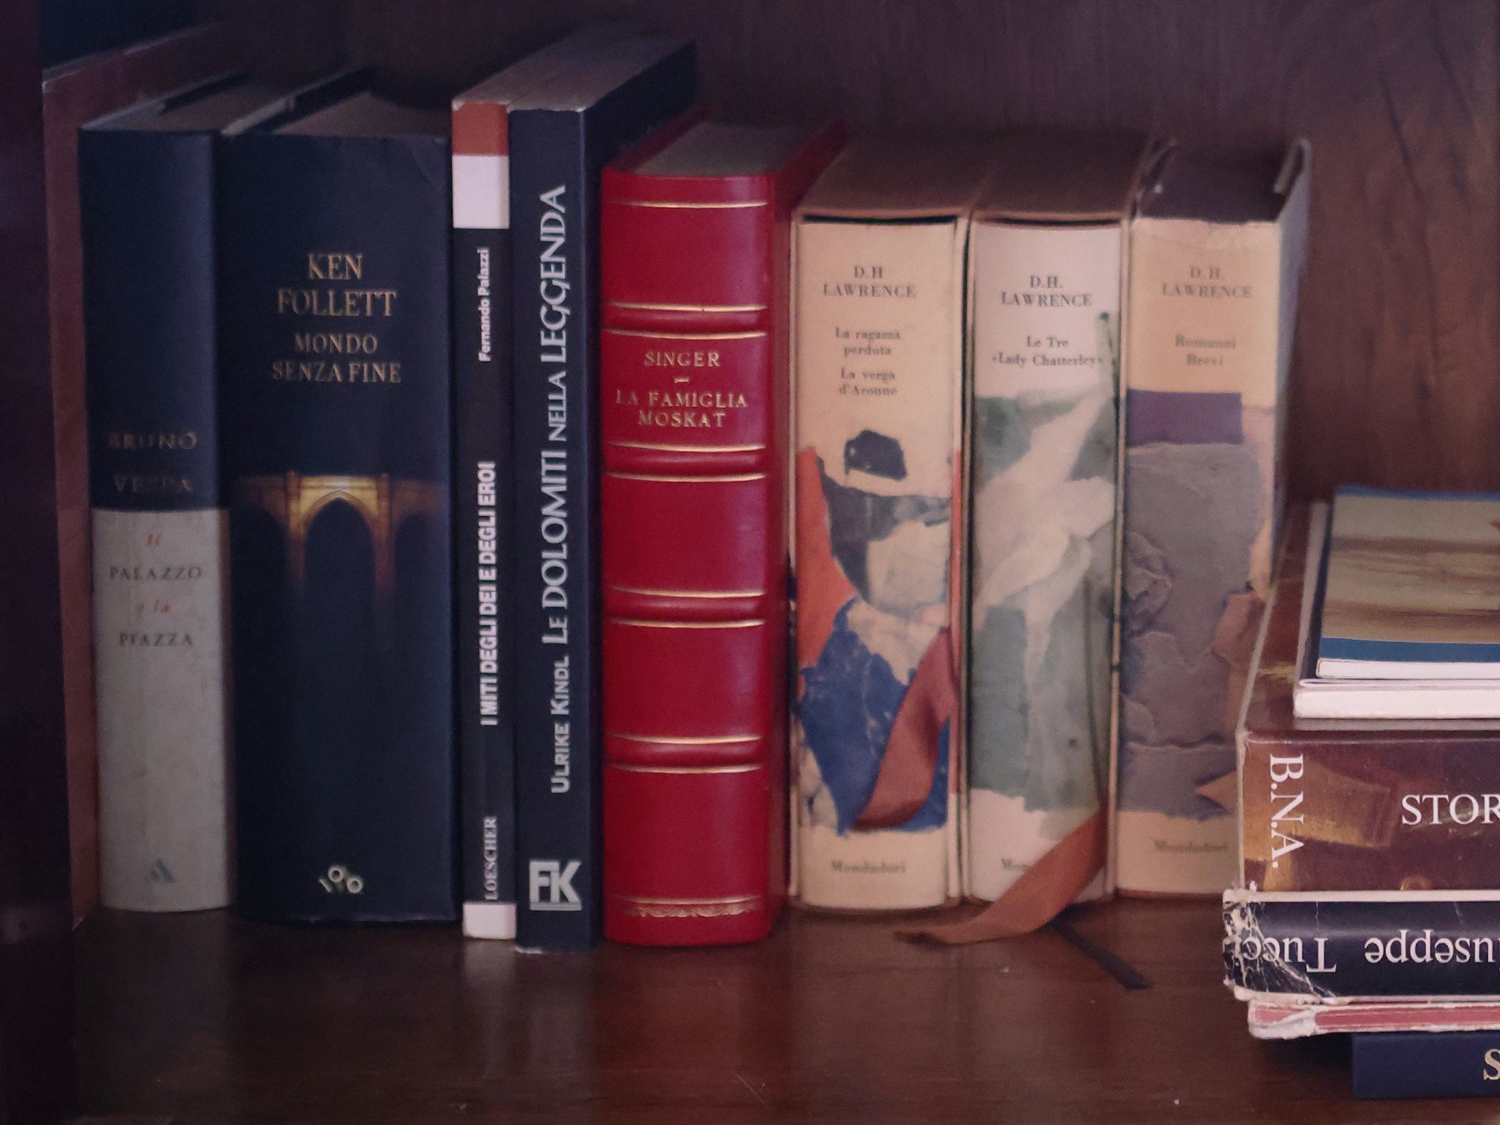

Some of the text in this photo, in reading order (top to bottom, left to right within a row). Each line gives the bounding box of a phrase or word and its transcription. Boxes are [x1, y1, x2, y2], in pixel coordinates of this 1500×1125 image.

[308, 253, 364, 281] KEN
[539, 184, 571, 364] LEGGENDA
[821, 283, 918, 299] LAWRENCE
[1000, 292, 1093, 309] LAWRENCE
[1160, 281, 1254, 299] LAWRENCE
[276, 289, 398, 317] FOLLETT
[477, 246, 491, 362] Fernando Palazzi
[294, 333, 379, 354] MONDO
[1026, 336, 1070, 349] Le Tre
[644, 351, 721, 368] SINGER
[271, 361, 402, 383] SENZA FINE
[547, 370, 567, 442] NELLA
[614, 389, 749, 409] LA FAMIGLIA
[638, 410, 727, 429] MOSKAT
[540, 450, 569, 610] DOLOMITI
[109, 565, 203, 581] PALAZZO
[477, 461, 498, 716] MITI DEGLI DEI E DEGLI EROI
[118, 632, 194, 647] PIAZZA
[550, 655, 570, 794] ULRIKE KINDL
[1268, 753, 1305, 869] B.N.A.
[483, 815, 498, 901] LOESCHER
[831, 859, 907, 875] Mondadori
[1238, 936, 1338, 974] Tucc
